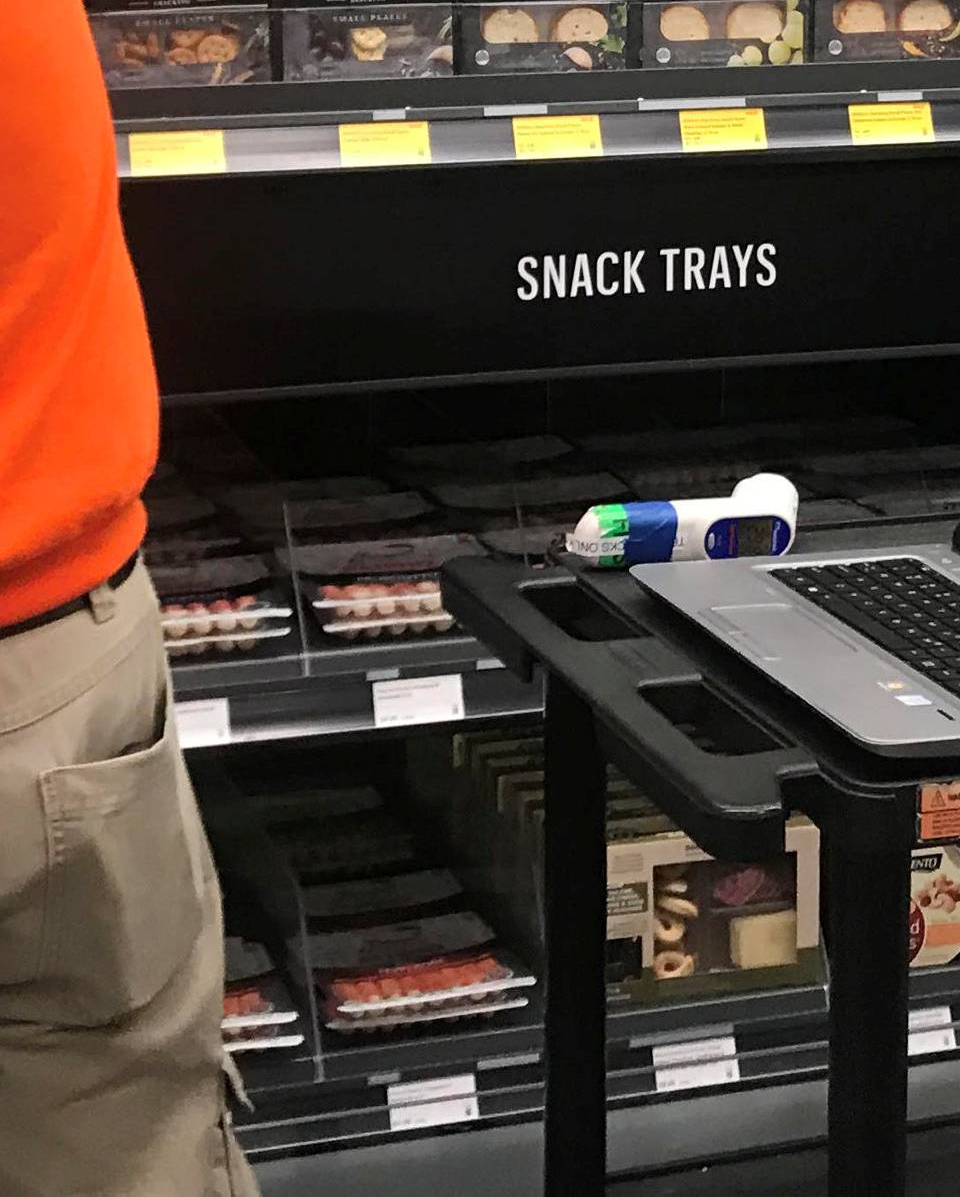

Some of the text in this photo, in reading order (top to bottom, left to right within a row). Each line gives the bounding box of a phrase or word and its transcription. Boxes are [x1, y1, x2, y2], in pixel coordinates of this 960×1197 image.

[516, 242, 778, 301] SNACK TRAYS
[911, 857, 938, 870] ENTO
